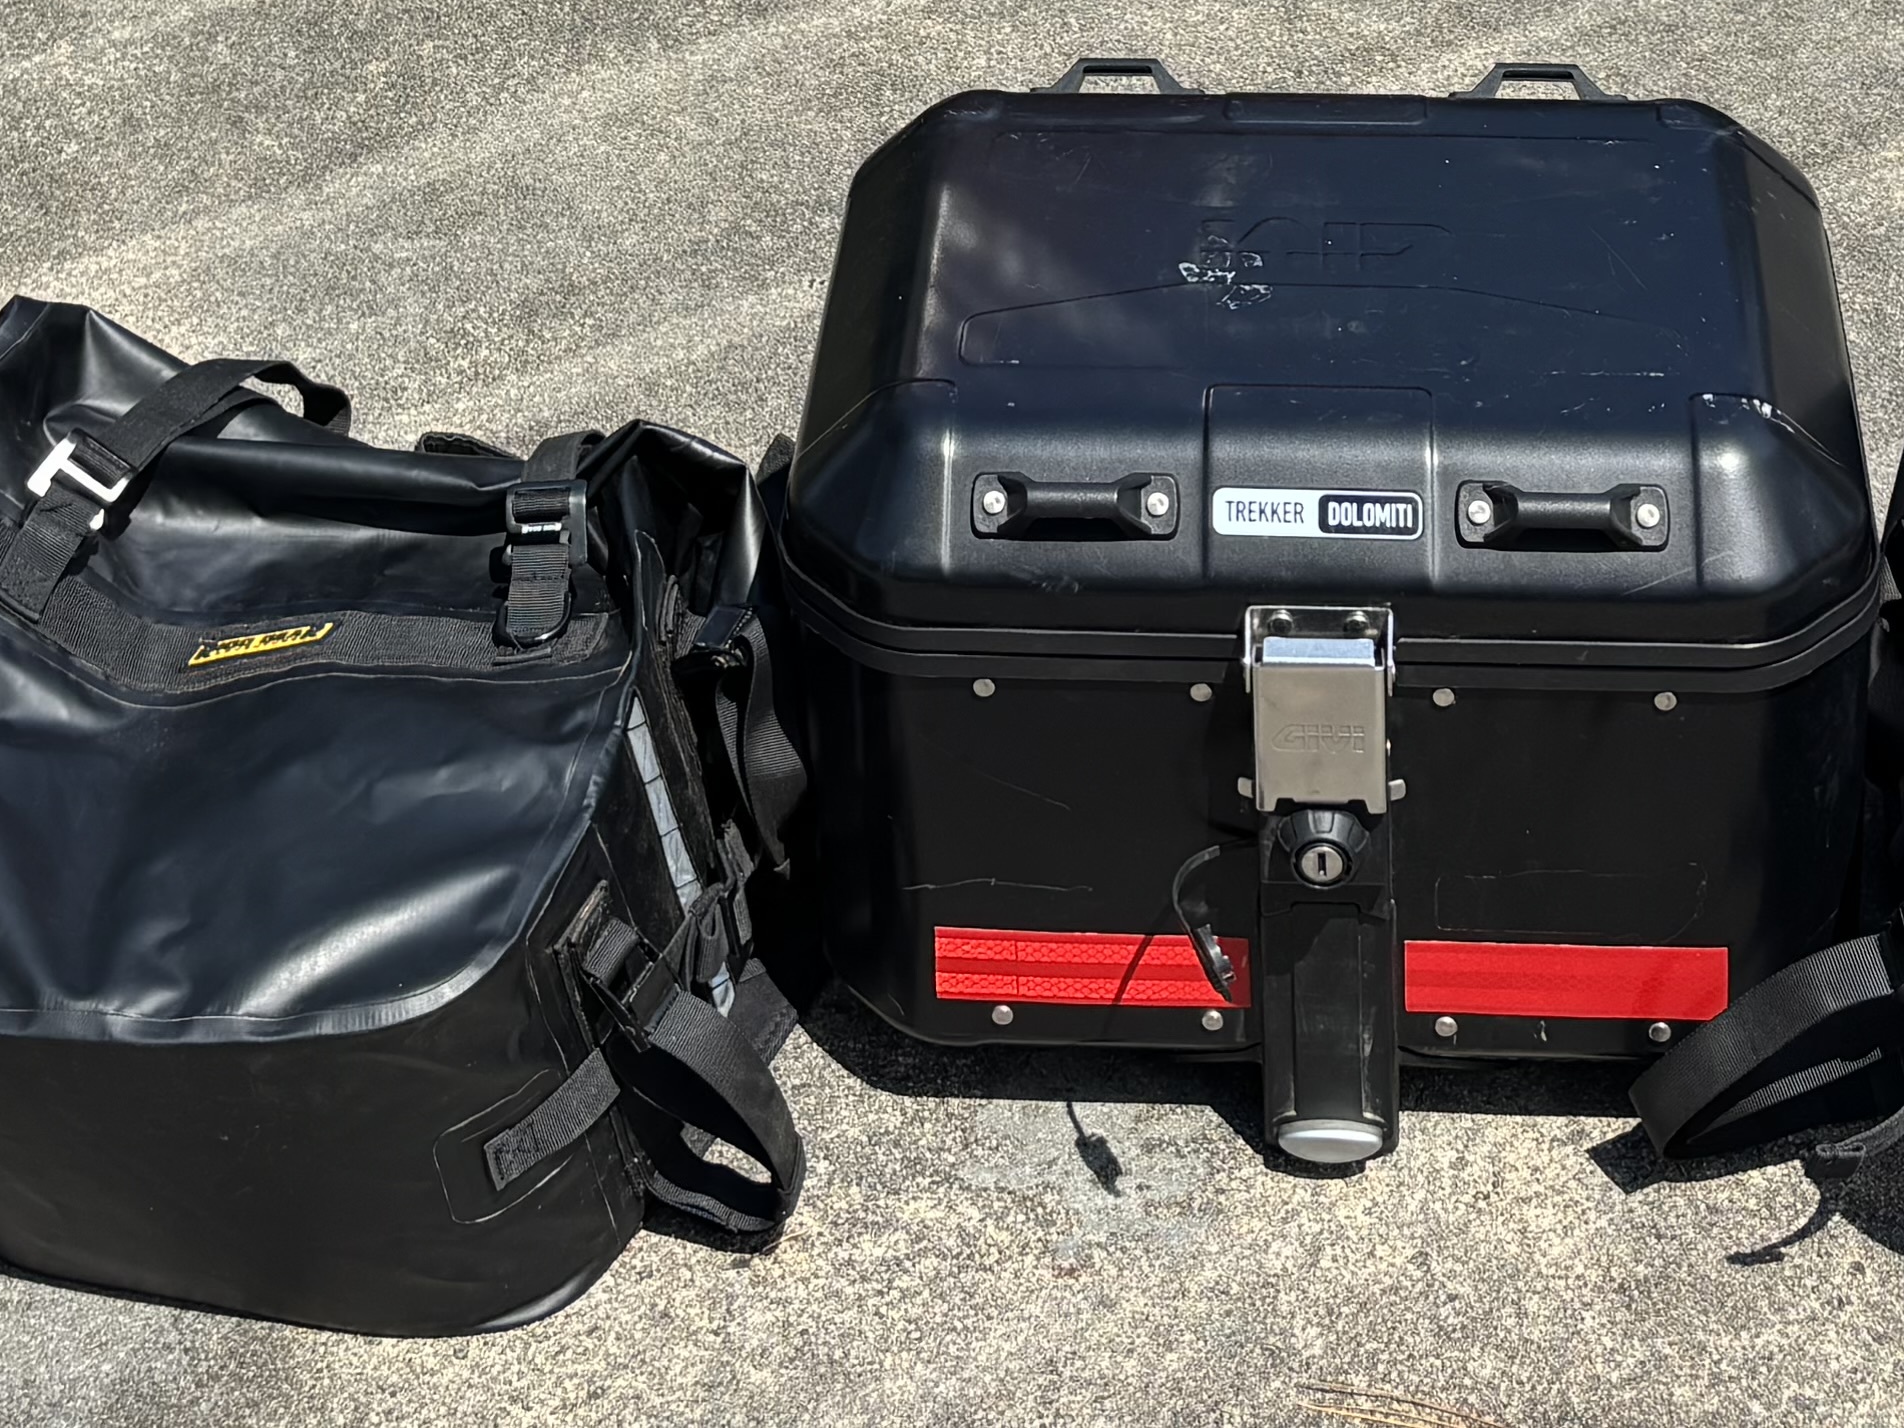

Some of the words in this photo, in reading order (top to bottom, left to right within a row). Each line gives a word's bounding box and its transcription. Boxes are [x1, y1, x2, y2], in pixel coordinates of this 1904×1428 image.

[1224, 499, 1305, 525] TREKKER
[1327, 501, 1414, 529] DOLOMITI
[1270, 723, 1366, 753] GIVI
